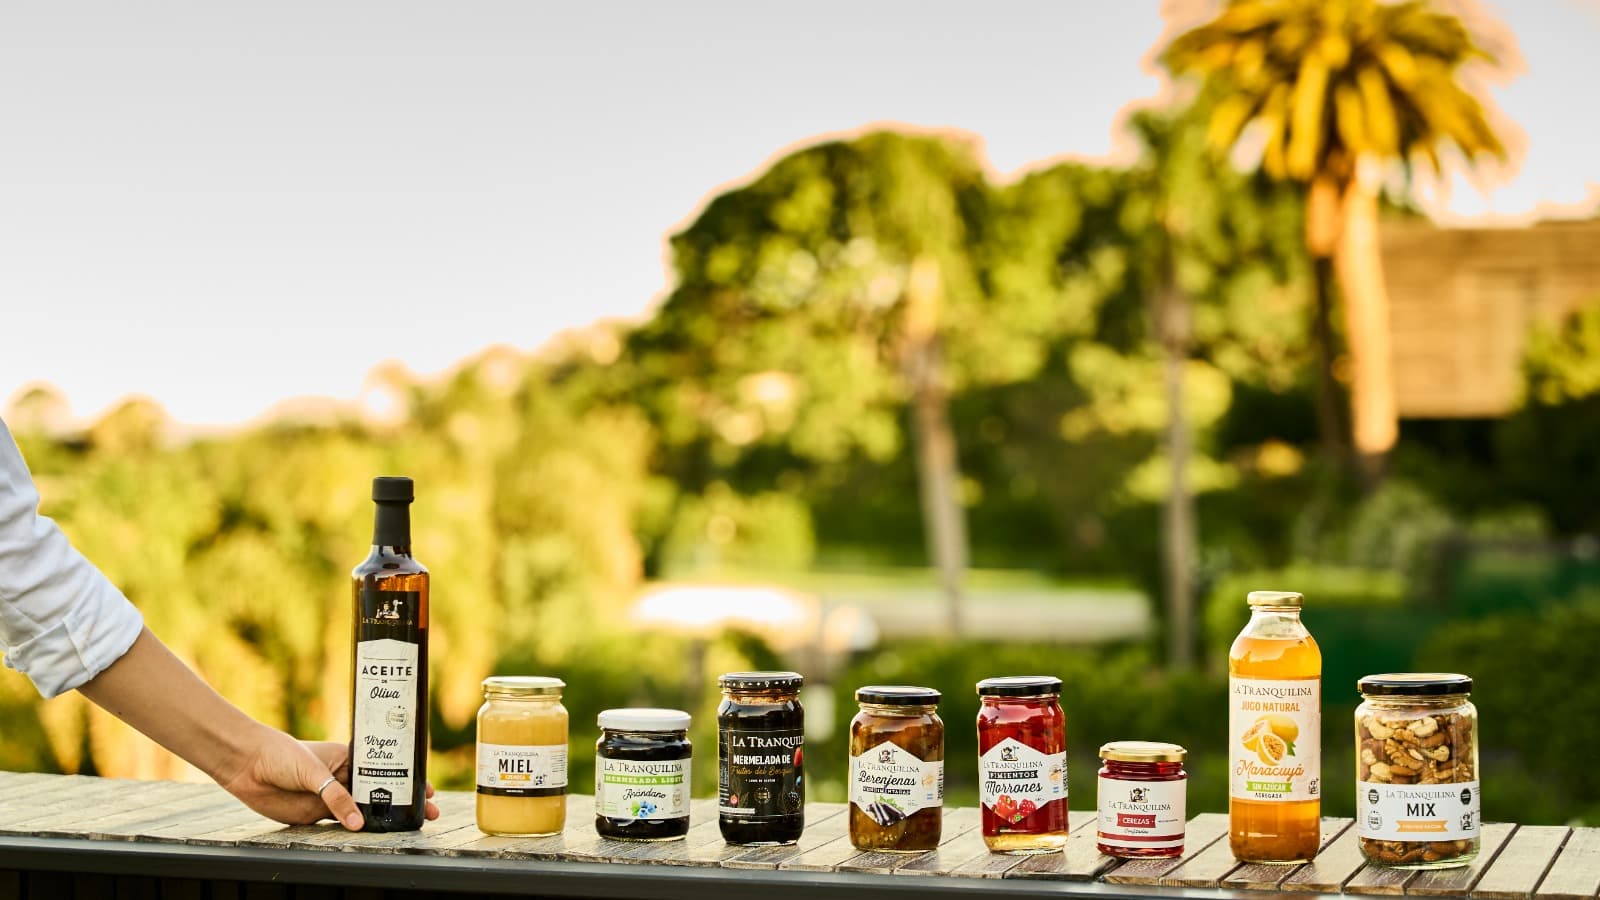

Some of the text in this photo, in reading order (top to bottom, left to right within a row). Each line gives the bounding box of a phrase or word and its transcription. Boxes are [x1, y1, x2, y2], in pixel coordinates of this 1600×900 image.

[362, 665, 413, 676] ACEITE
[370, 686, 400, 699] Oliva
[1242, 685, 1312, 698] TRANQUILINA
[1241, 701, 1300, 712] JUGO NATURAL
[365, 735, 398, 749] Virgen
[732, 735, 745, 747] LA
[366, 748, 394, 759] Extra
[498, 759, 533, 773] MIEL
[733, 755, 791, 765] MERMELADA DE
[983, 760, 1043, 770] LA TRANQUILINA
[604, 760, 683, 775] LA TRANQUILINA
[730, 765, 752, 775] Frutos
[754, 765, 766, 775] del
[858, 760, 920, 773] LA TRANQUILINA
[1236, 760, 1304, 782] Maracuyá
[605, 775, 657, 783] MERMELADA
[858, 770, 916, 788] Berenjenas
[989, 771, 1035, 779] PIMIENTOS
[985, 780, 1043, 796] Morrones
[1252, 782, 1286, 791] SIN AZÚCAR
[623, 788, 666, 800] Arándano
[1385, 790, 1395, 798] LA
[1397, 790, 1456, 800] TRANQUILINA
[1108, 800, 1171, 812] LA TRANQUILINA
[1406, 803, 1436, 817] MIX
[1123, 817, 1150, 825] CEREZAS
